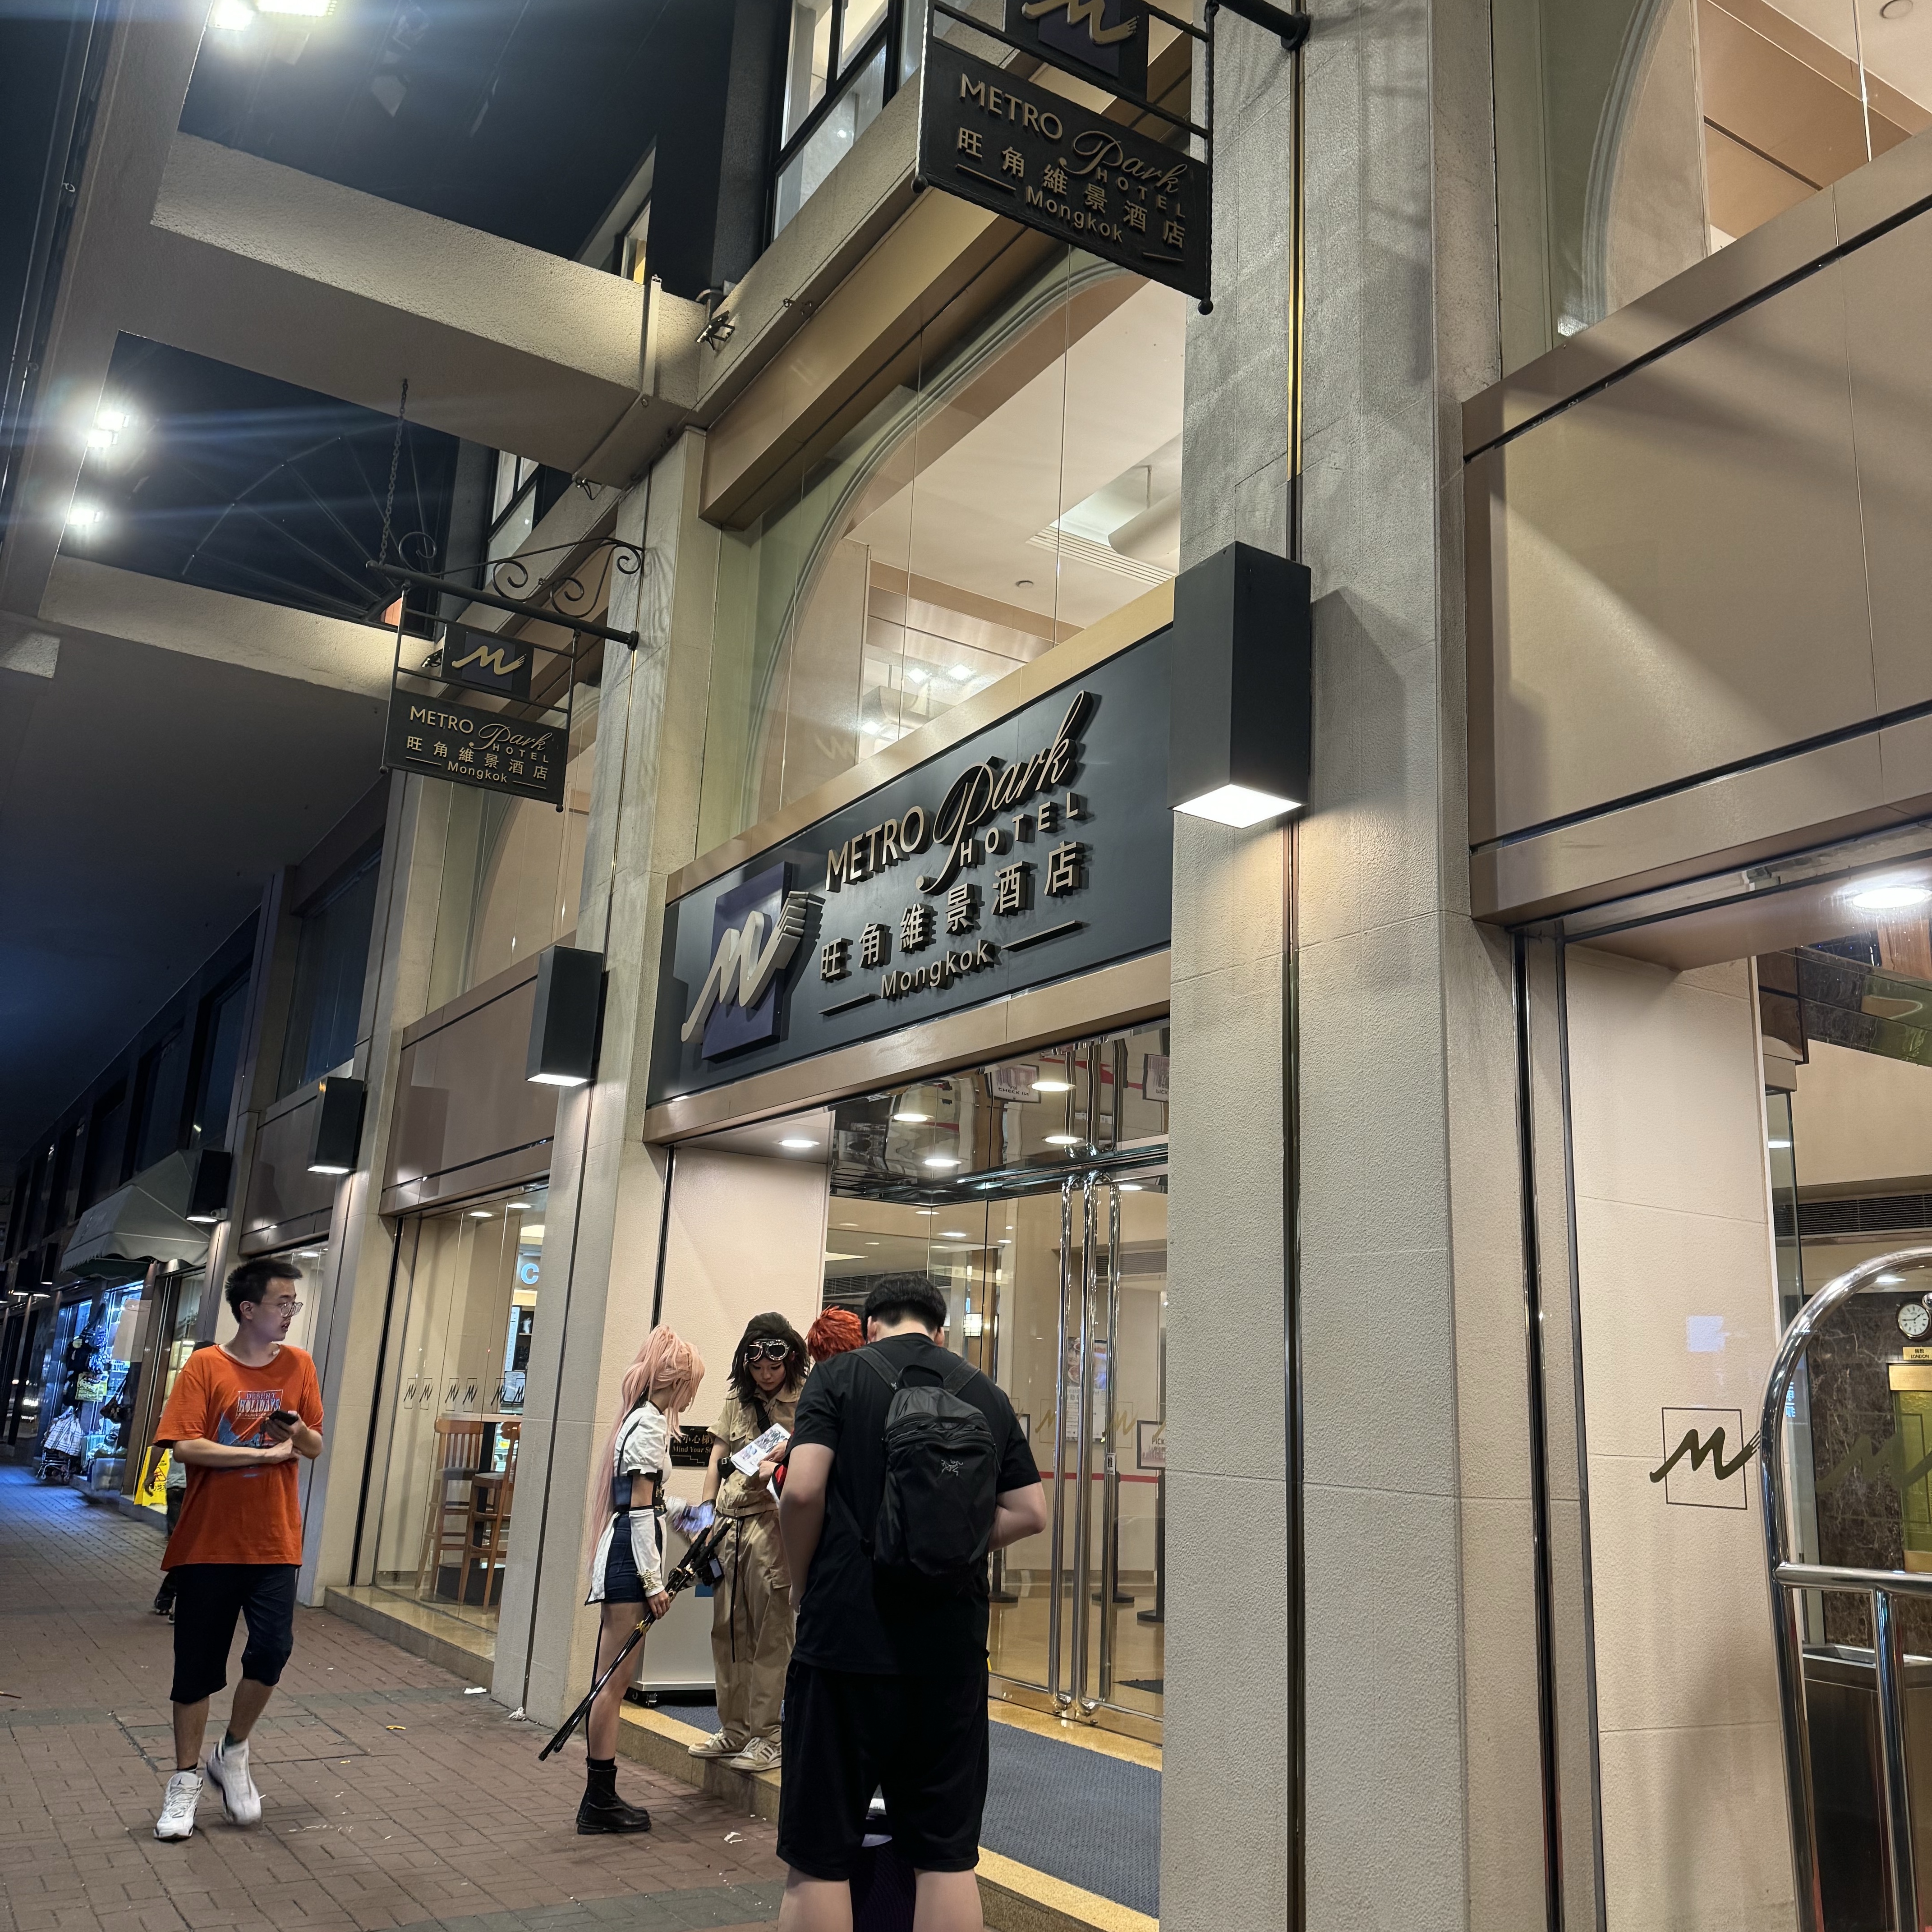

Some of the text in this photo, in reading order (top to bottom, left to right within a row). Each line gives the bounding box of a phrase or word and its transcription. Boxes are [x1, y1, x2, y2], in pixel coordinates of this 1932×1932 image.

[959, 73, 1188, 194] METRO Park
[957, 126, 1185, 249] 旺角維景酒店
[1026, 185, 1122, 244] Mongkok
[1096, 166, 1186, 219] HOTEL
[406, 735, 548, 781] 旺角維景酒店
[409, 706, 553, 751] METRO Park
[492, 743, 549, 764] HOTEL
[447, 760, 507, 783] Mongkok
[826, 690, 1088, 894] METRO Park
[960, 791, 1080, 868] HOTEL
[819, 840, 1079, 981] 旺角維景酒店
[880, 938, 991, 999] Mongkok
